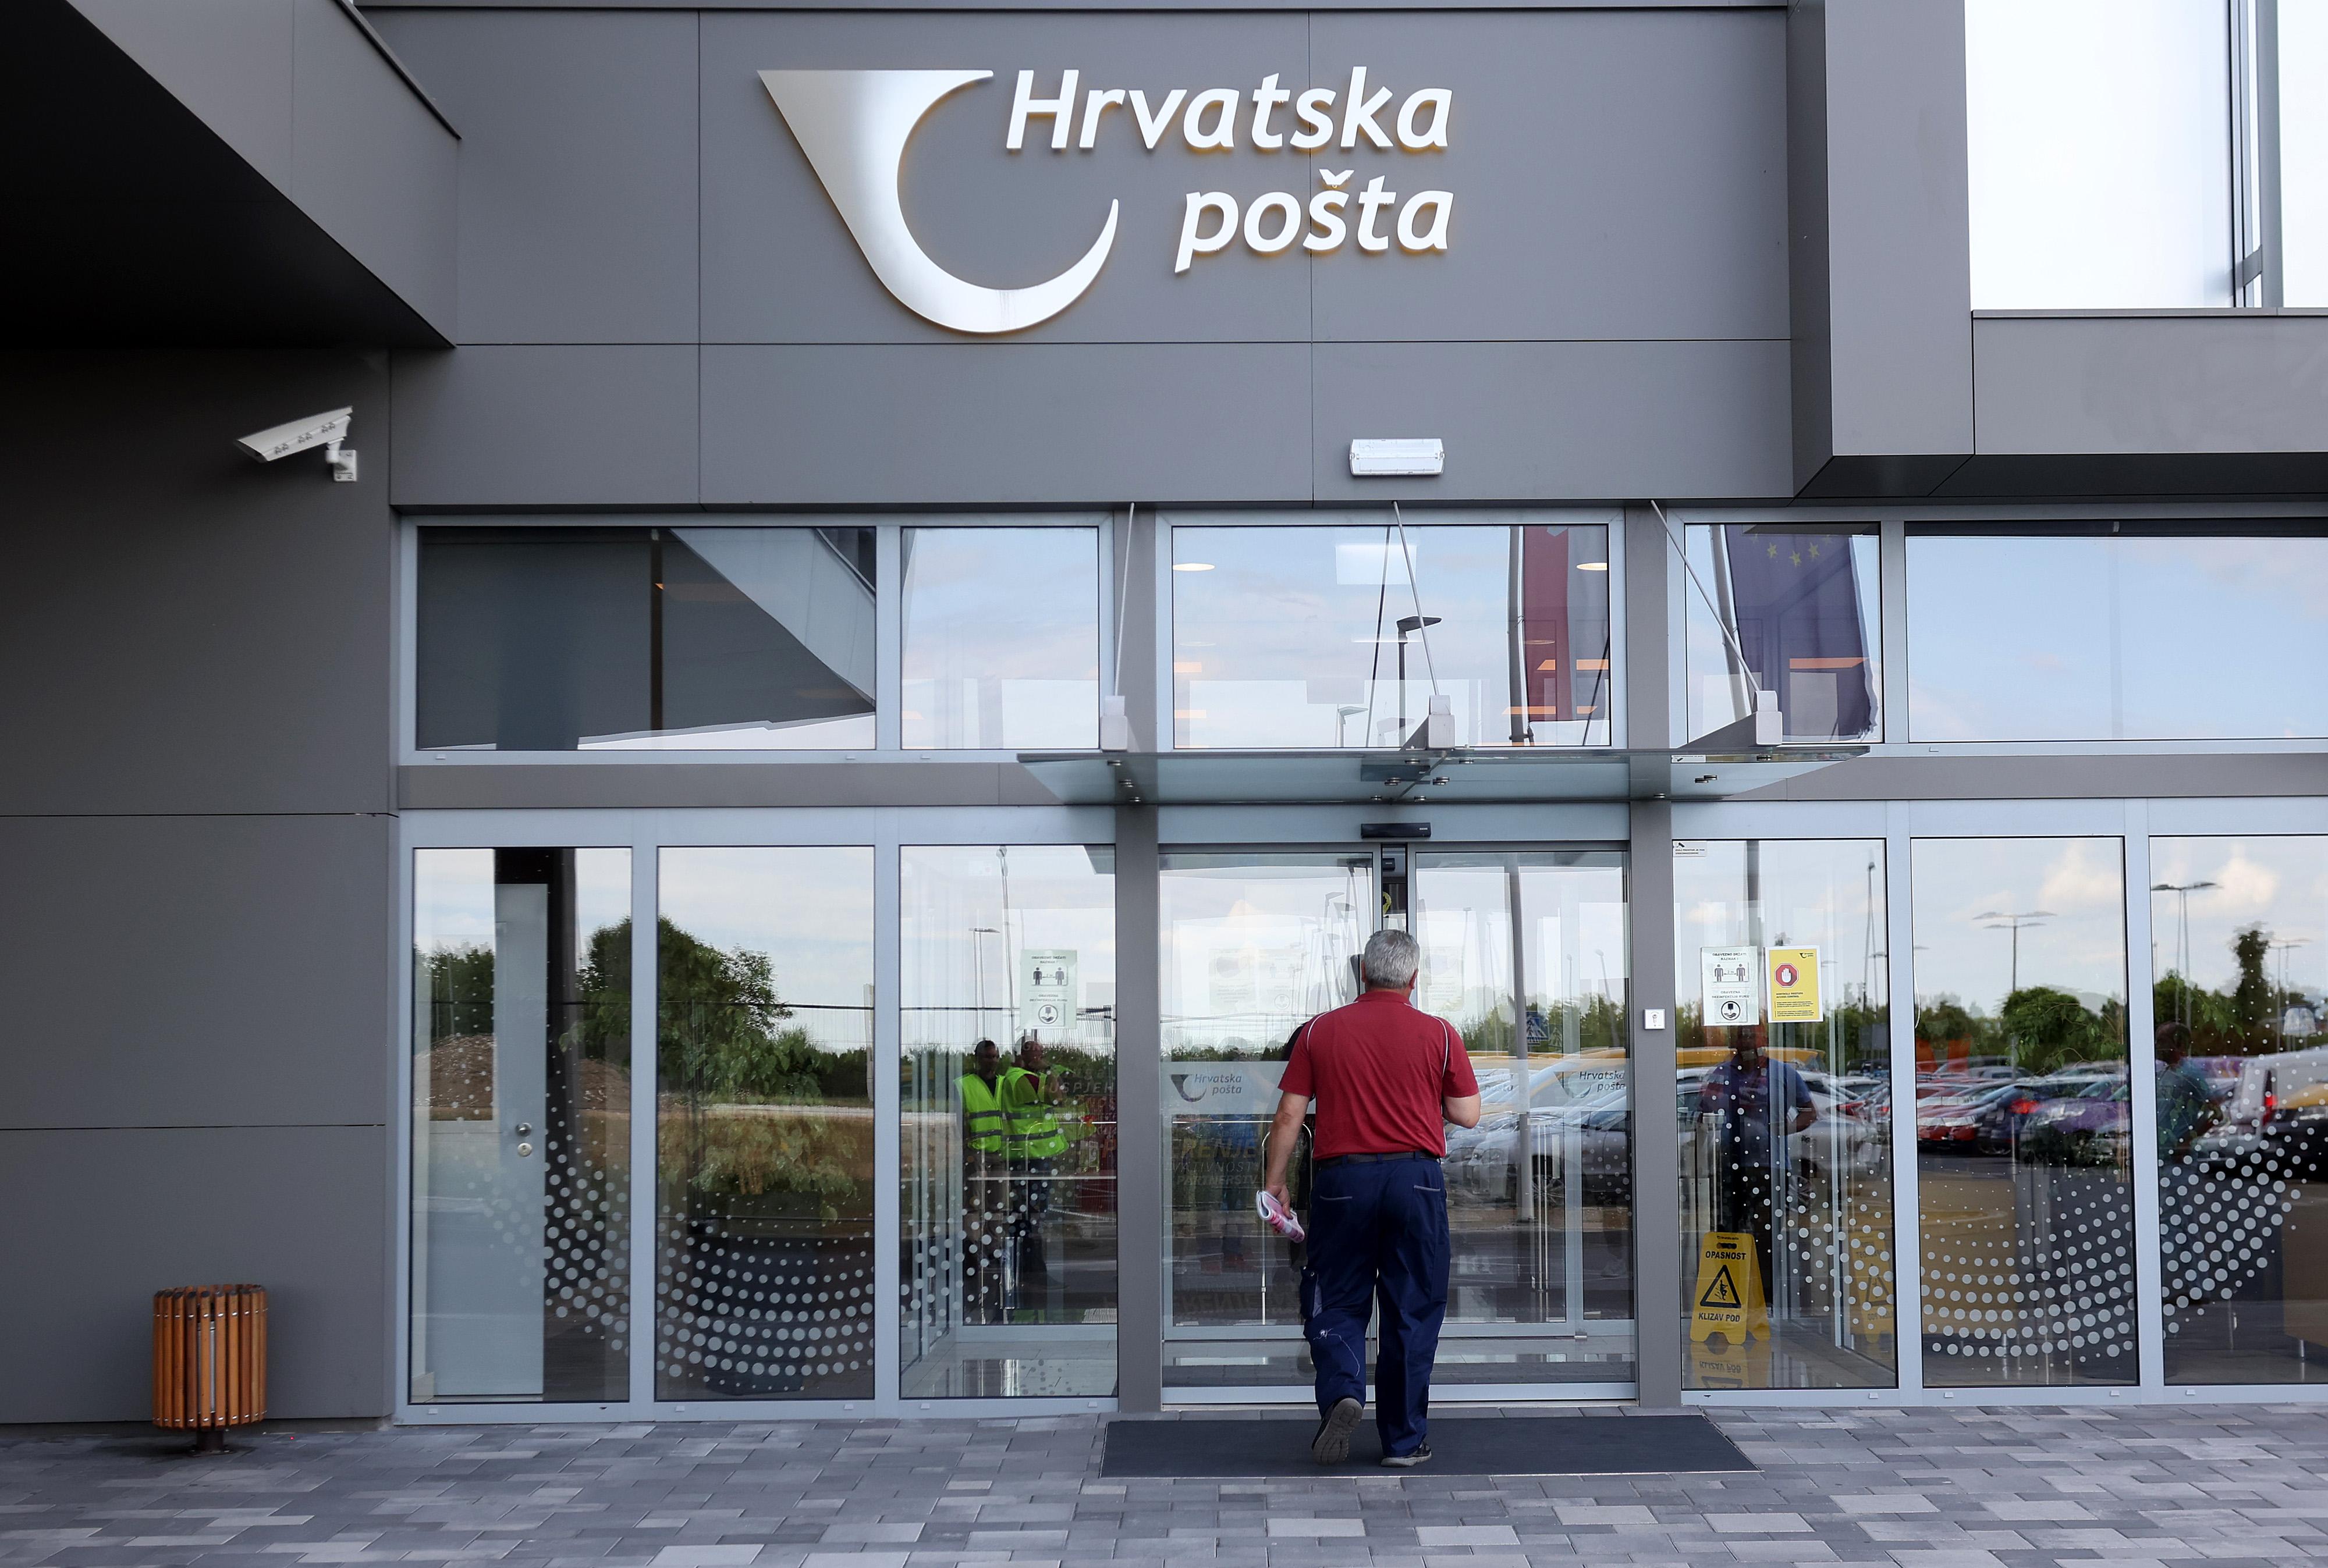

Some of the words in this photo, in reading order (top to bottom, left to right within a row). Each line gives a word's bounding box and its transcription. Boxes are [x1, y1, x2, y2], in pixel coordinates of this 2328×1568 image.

[1006, 66, 1453, 150] Hrvatska
[1174, 169, 1454, 273] pošta
[1195, 1073, 1242, 1083] Hrvatska
[1580, 1071, 1626, 1080] Hrvatska
[1212, 1085, 1242, 1096] pošta
[1705, 1251, 1746, 1260] OPASNOST
[1698, 1312, 1724, 1321] KLIZAV
[1726, 1314, 1740, 1322] POD
